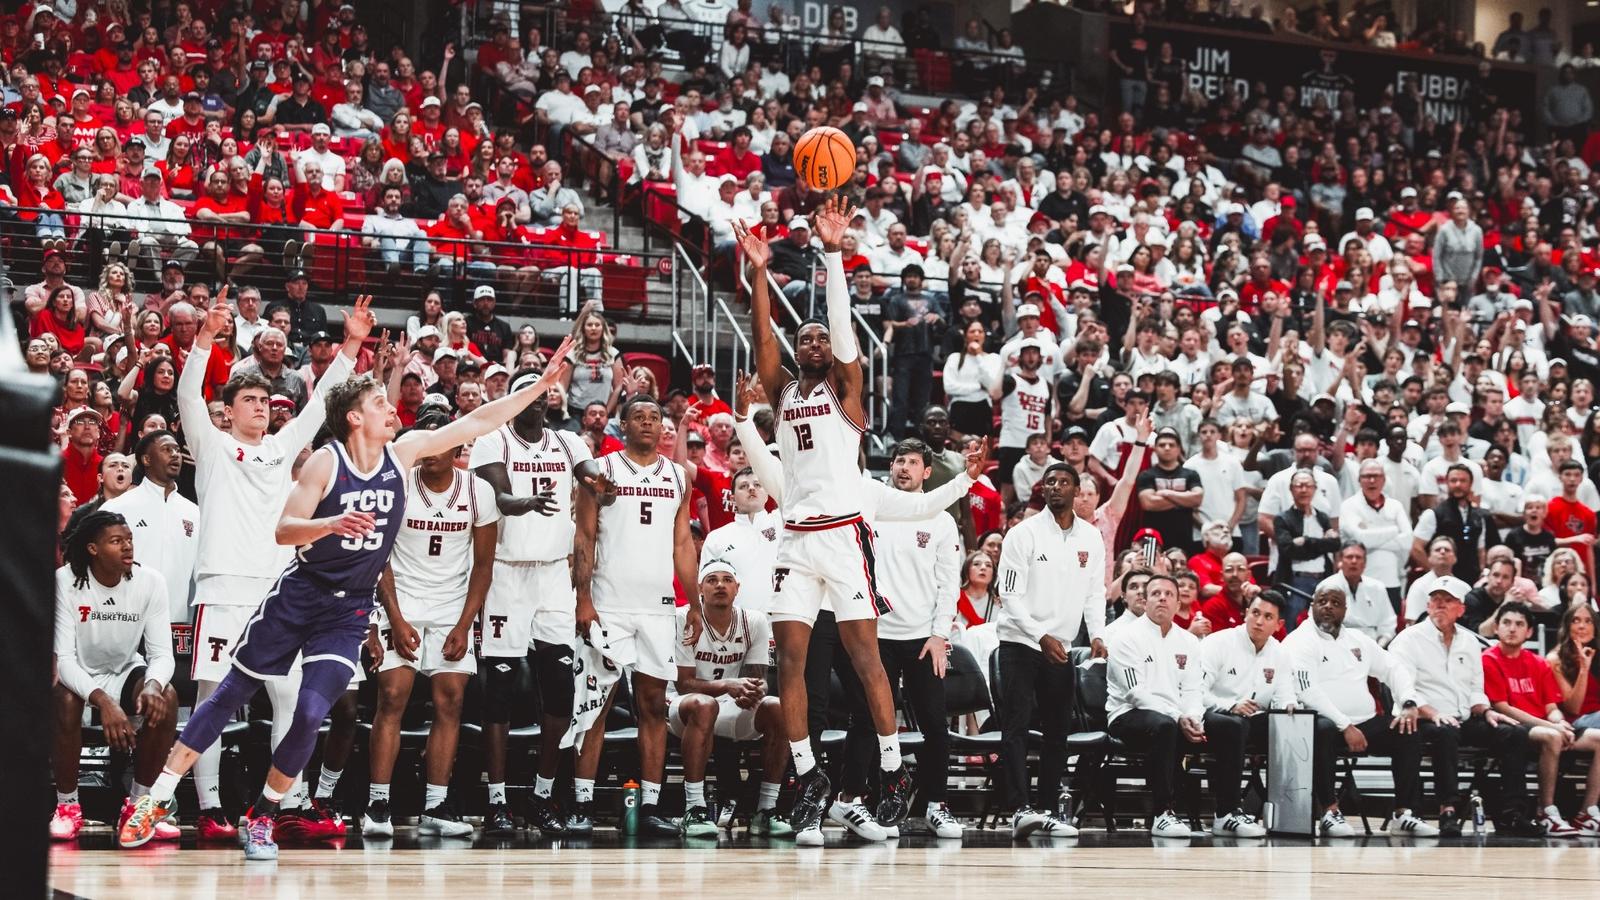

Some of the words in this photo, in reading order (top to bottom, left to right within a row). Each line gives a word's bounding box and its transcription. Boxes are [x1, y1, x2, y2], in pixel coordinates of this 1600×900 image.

[1189, 48, 1230, 74] JIM
[1027, 414, 1039, 429] 15
[793, 423, 814, 451] 12
[513, 461, 531, 472] RED
[532, 462, 566, 473] RAIDERS
[340, 489, 395, 514] TCU
[617, 486, 634, 496] RED
[636, 487, 675, 499] RAIDERS
[640, 501, 653, 525] 5
[407, 518, 426, 530] RED
[427, 520, 468, 532] RAIDERS
[428, 535, 443, 556] 6
[695, 650, 713, 662] RED
